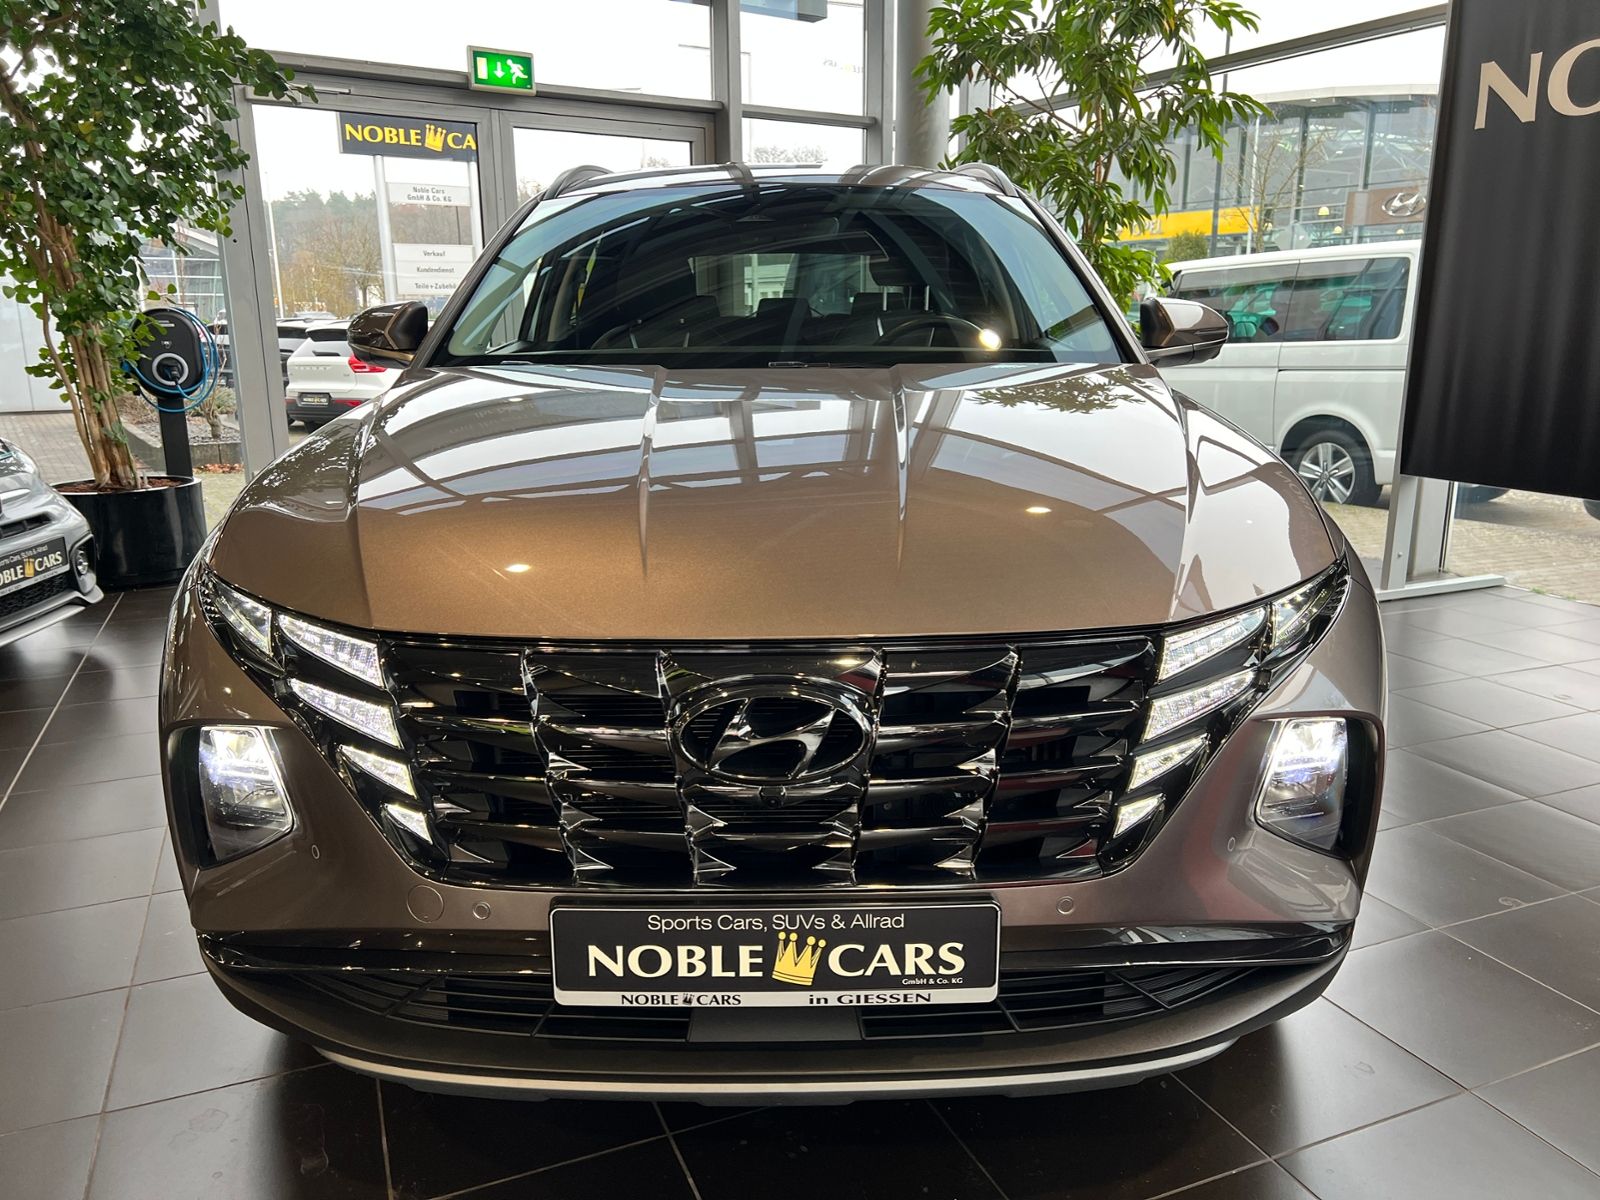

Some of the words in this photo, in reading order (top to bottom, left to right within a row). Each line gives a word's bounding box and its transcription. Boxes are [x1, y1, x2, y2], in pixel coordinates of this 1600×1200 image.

[1474, 38, 1600, 130] NO
[344, 123, 422, 146] NOBLE
[446, 132, 477, 150] CA
[412, 186, 430, 194] Noble
[431, 187, 445, 195] Cars
[35, 551, 63, 571] CARS
[647, 914, 713, 933] Sports
[717, 914, 768, 932] Cars,
[772, 914, 826, 930] SUVs
[831, 914, 846, 929] &
[850, 913, 905, 929] Allrad
[588, 945, 763, 978] NOBLE
[828, 942, 966, 977] CARS
[621, 994, 679, 1006] NOBLE
[696, 994, 741, 1006] CARS
[809, 994, 828, 1005] in
[837, 993, 932, 1005] GIESSEN
